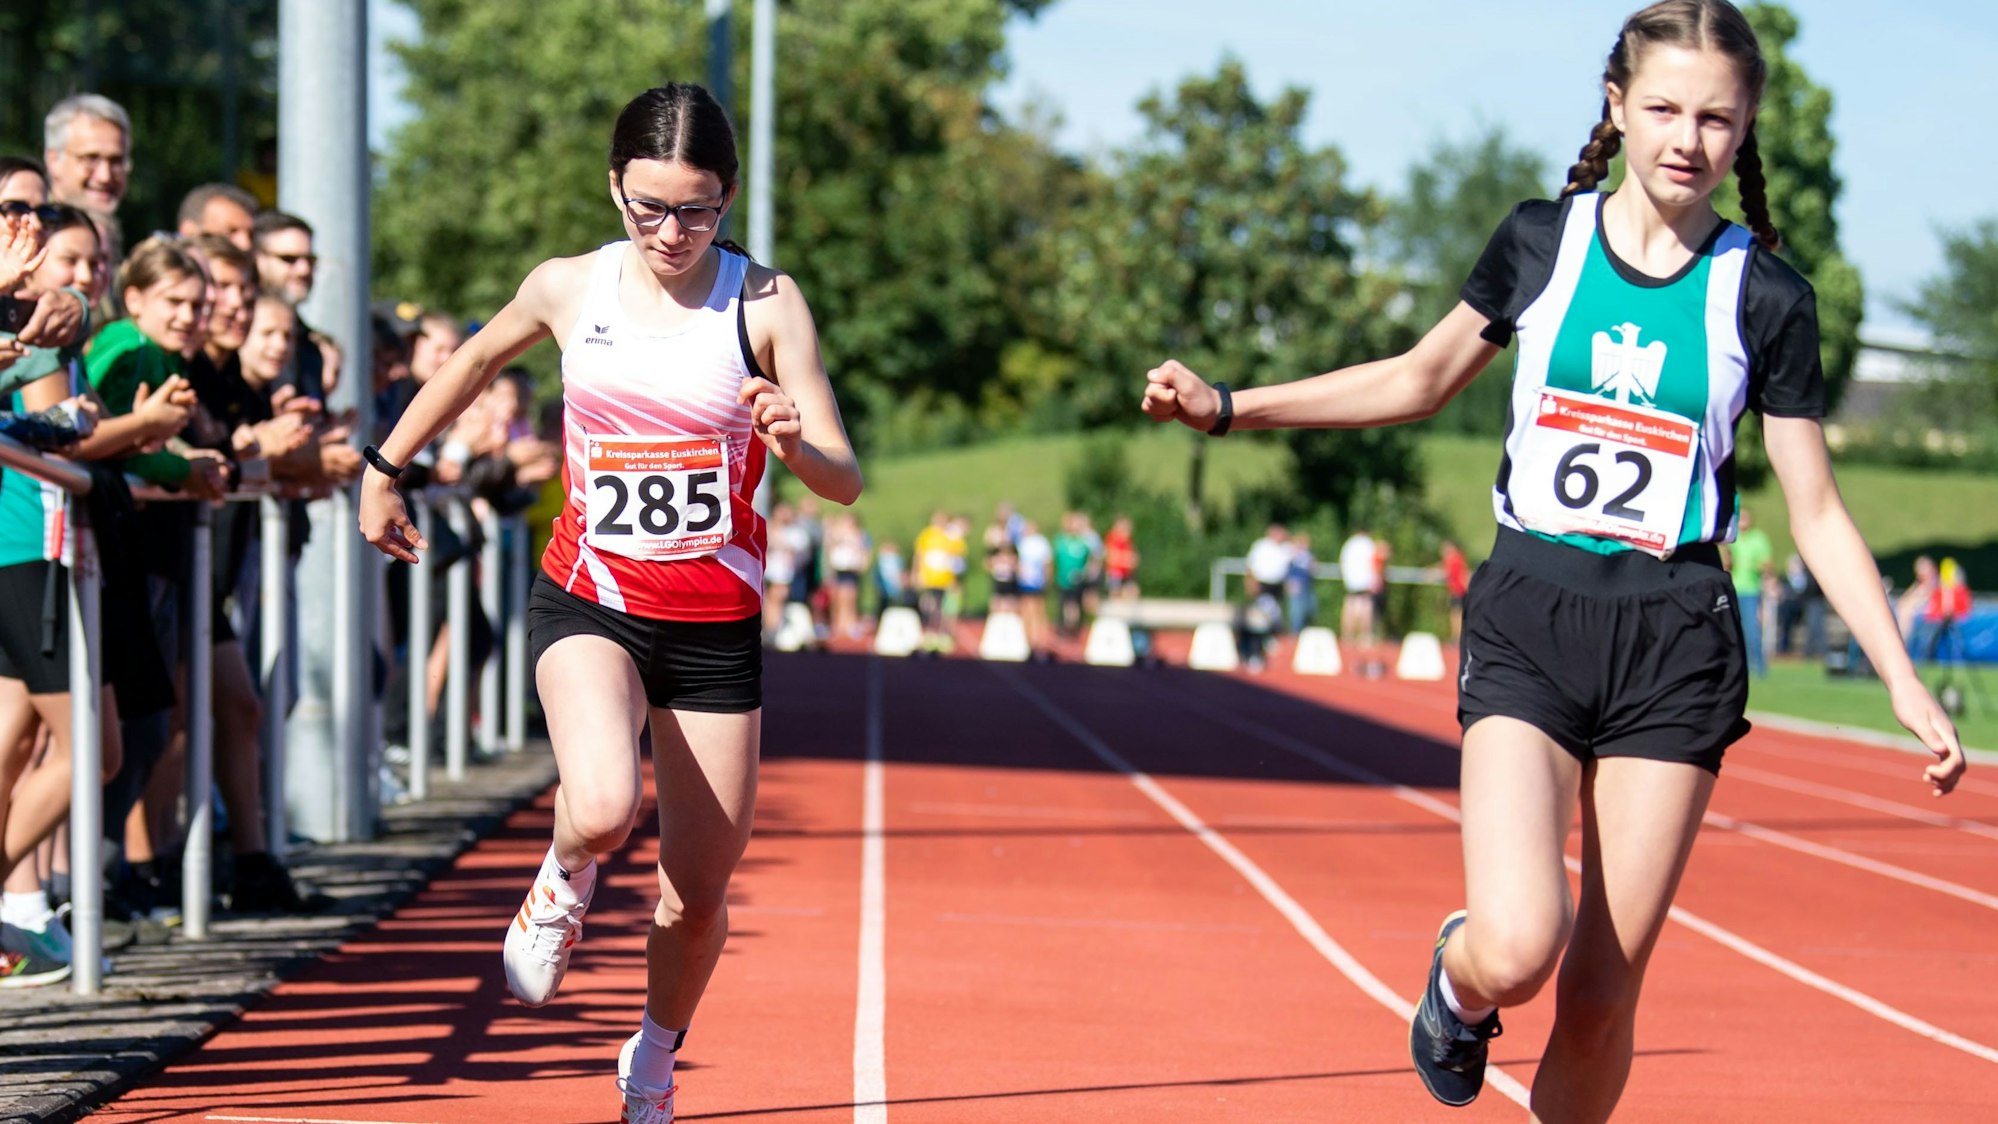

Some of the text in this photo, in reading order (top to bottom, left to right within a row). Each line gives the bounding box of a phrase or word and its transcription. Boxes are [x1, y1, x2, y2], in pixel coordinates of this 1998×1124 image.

[585, 336, 613, 347] erima
[1559, 406, 1690, 443] Kreissparkasse Euskirchen
[1578, 424, 1593, 434] Gut
[1593, 425, 1606, 436] für
[1606, 429, 1623, 439] den
[606, 447, 719, 460] Kreissparkasse Euskirchen
[624, 462, 684, 471] Gut für den Sport.
[1554, 443, 1652, 522] 62
[593, 471, 721, 535] 285
